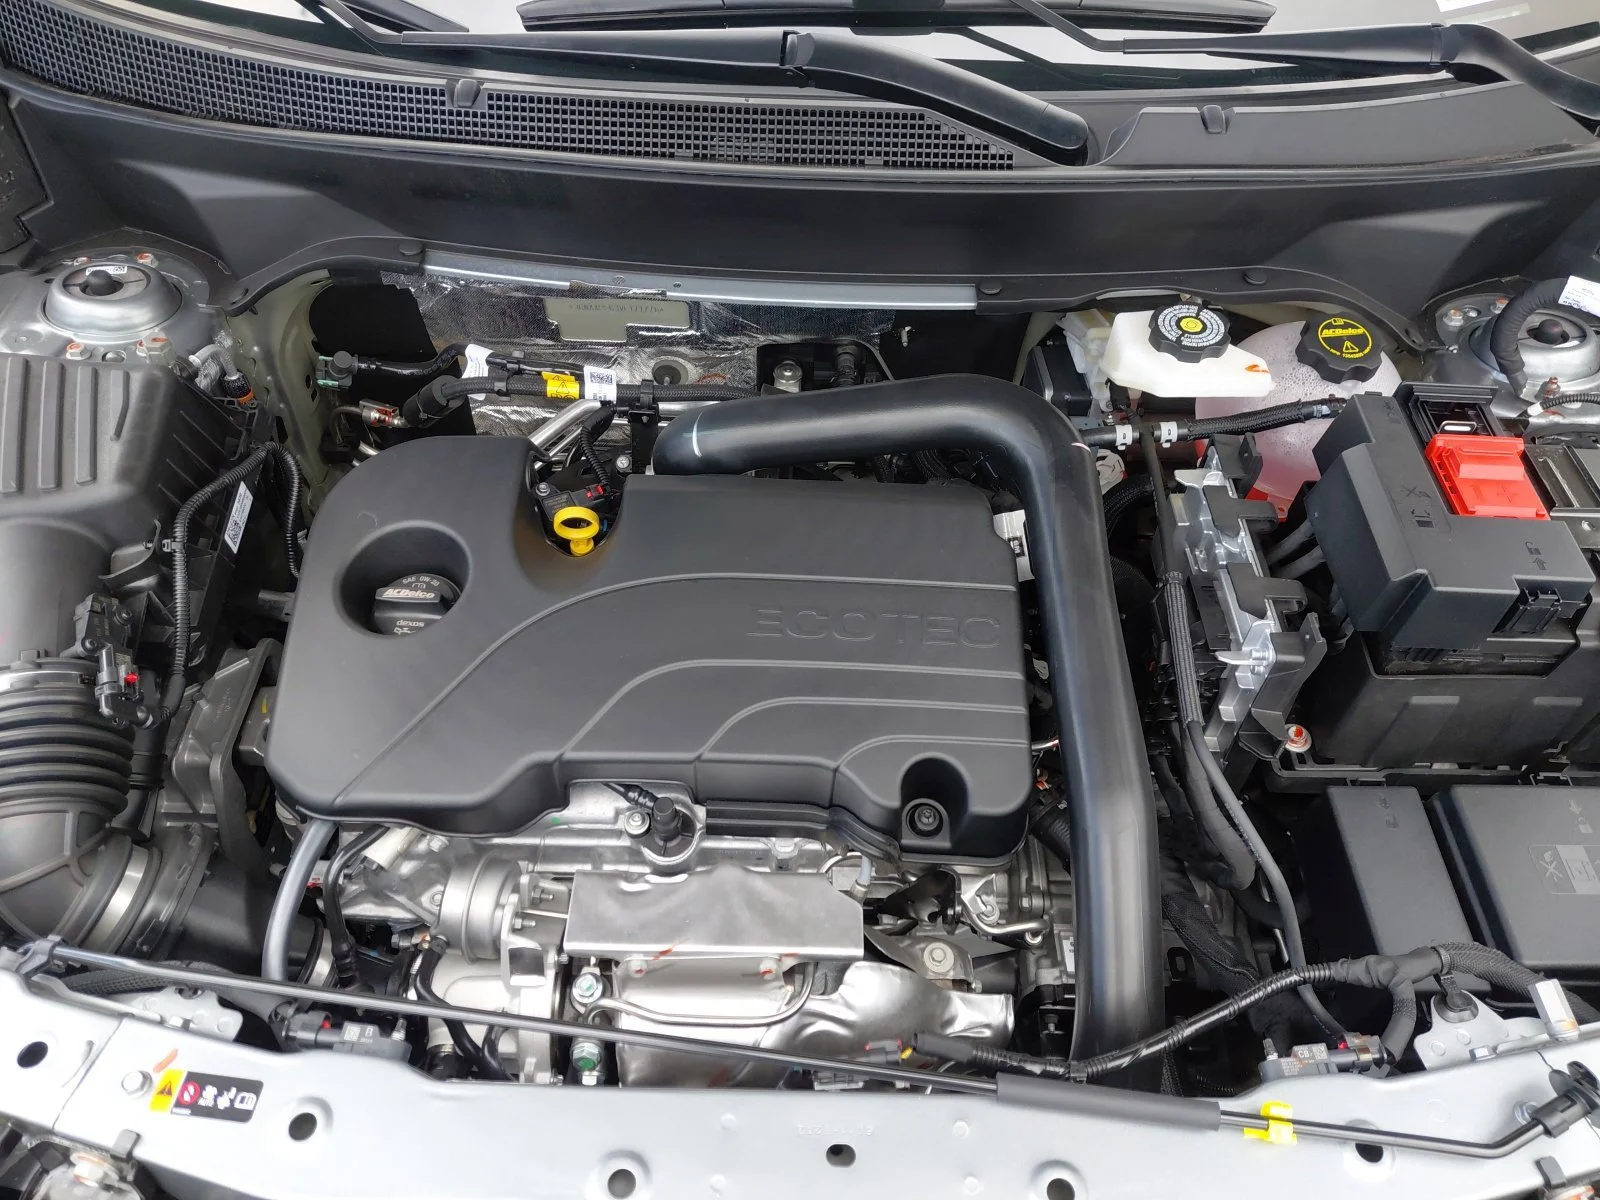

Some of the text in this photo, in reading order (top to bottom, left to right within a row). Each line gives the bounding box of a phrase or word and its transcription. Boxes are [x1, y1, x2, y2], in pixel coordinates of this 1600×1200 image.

[402, 576, 417, 585] SAE
[382, 588, 436, 599] ACDelco
[396, 620, 425, 628] dexos
[746, 609, 1001, 649] ECOTEC
